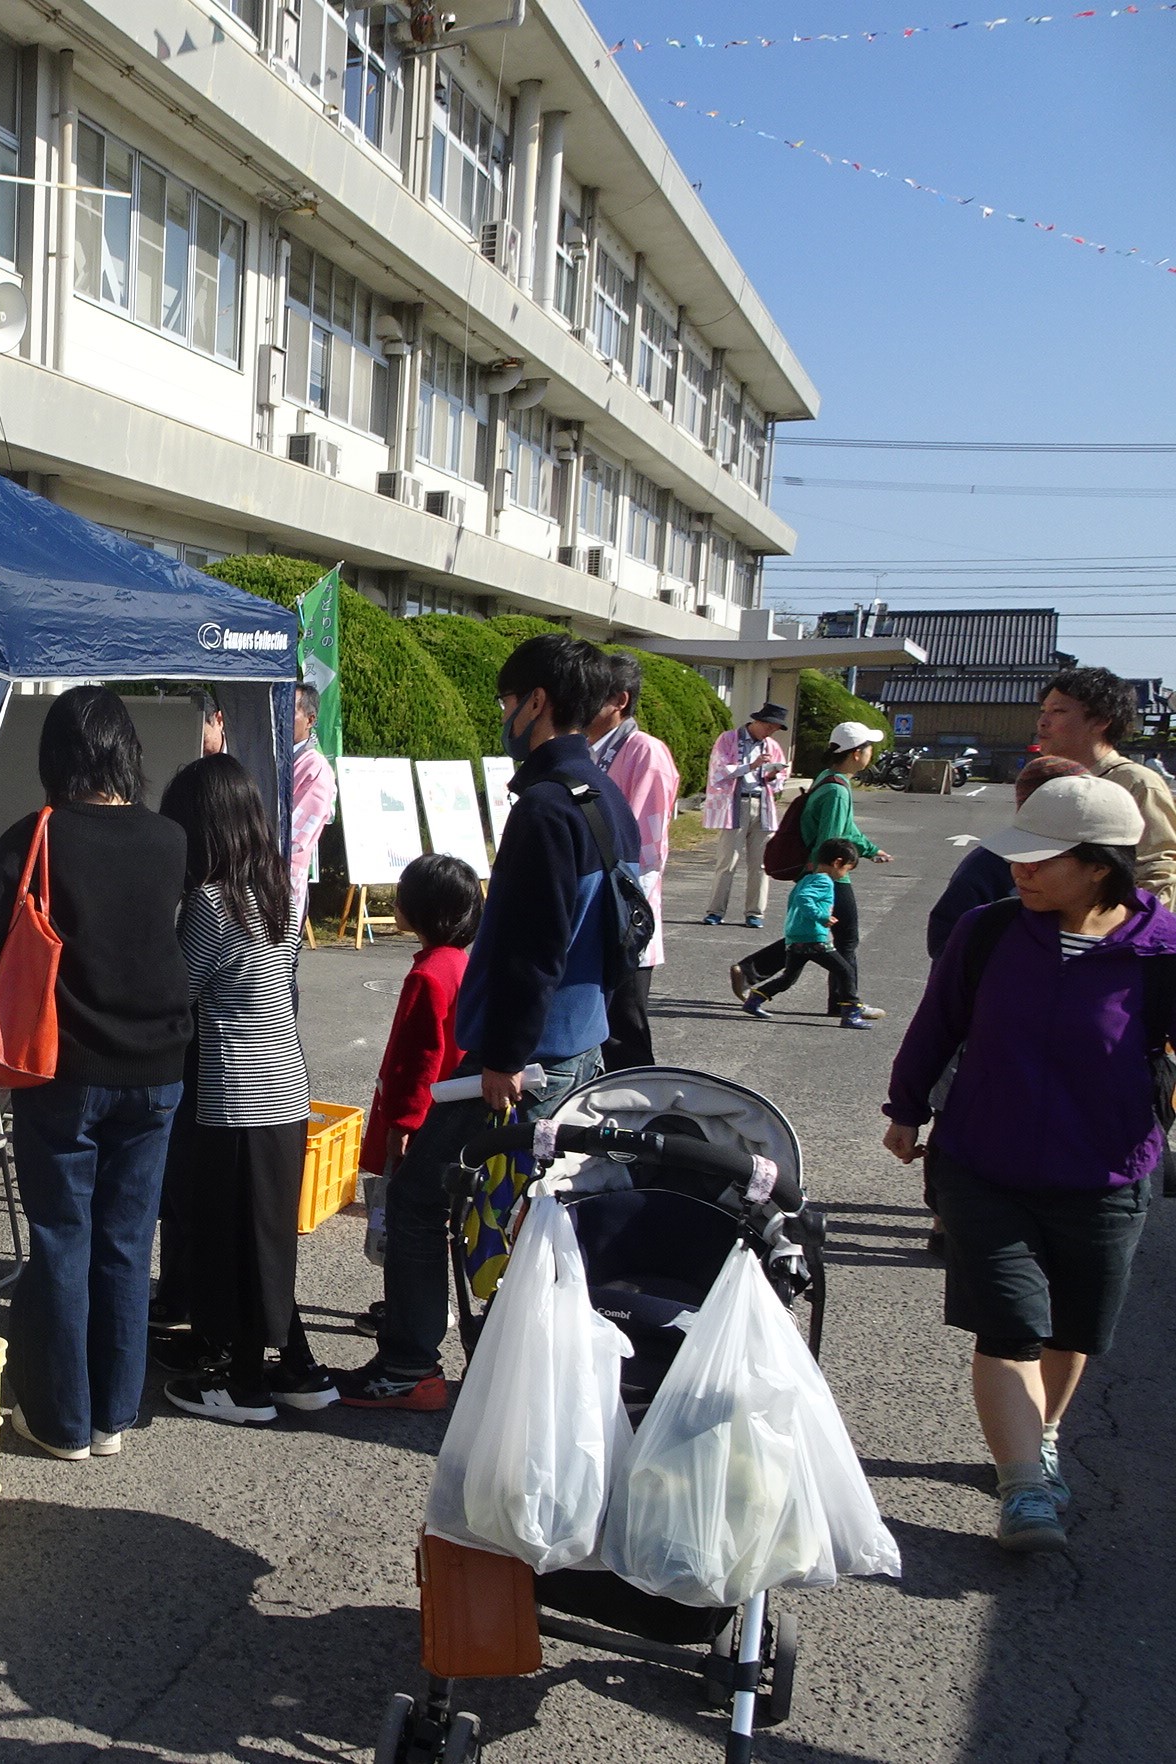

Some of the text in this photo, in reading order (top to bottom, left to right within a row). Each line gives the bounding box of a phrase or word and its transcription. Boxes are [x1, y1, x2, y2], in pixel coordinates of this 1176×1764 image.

[223, 628, 288, 651] Campers Collection
[597, 1307, 632, 1320] Combi
